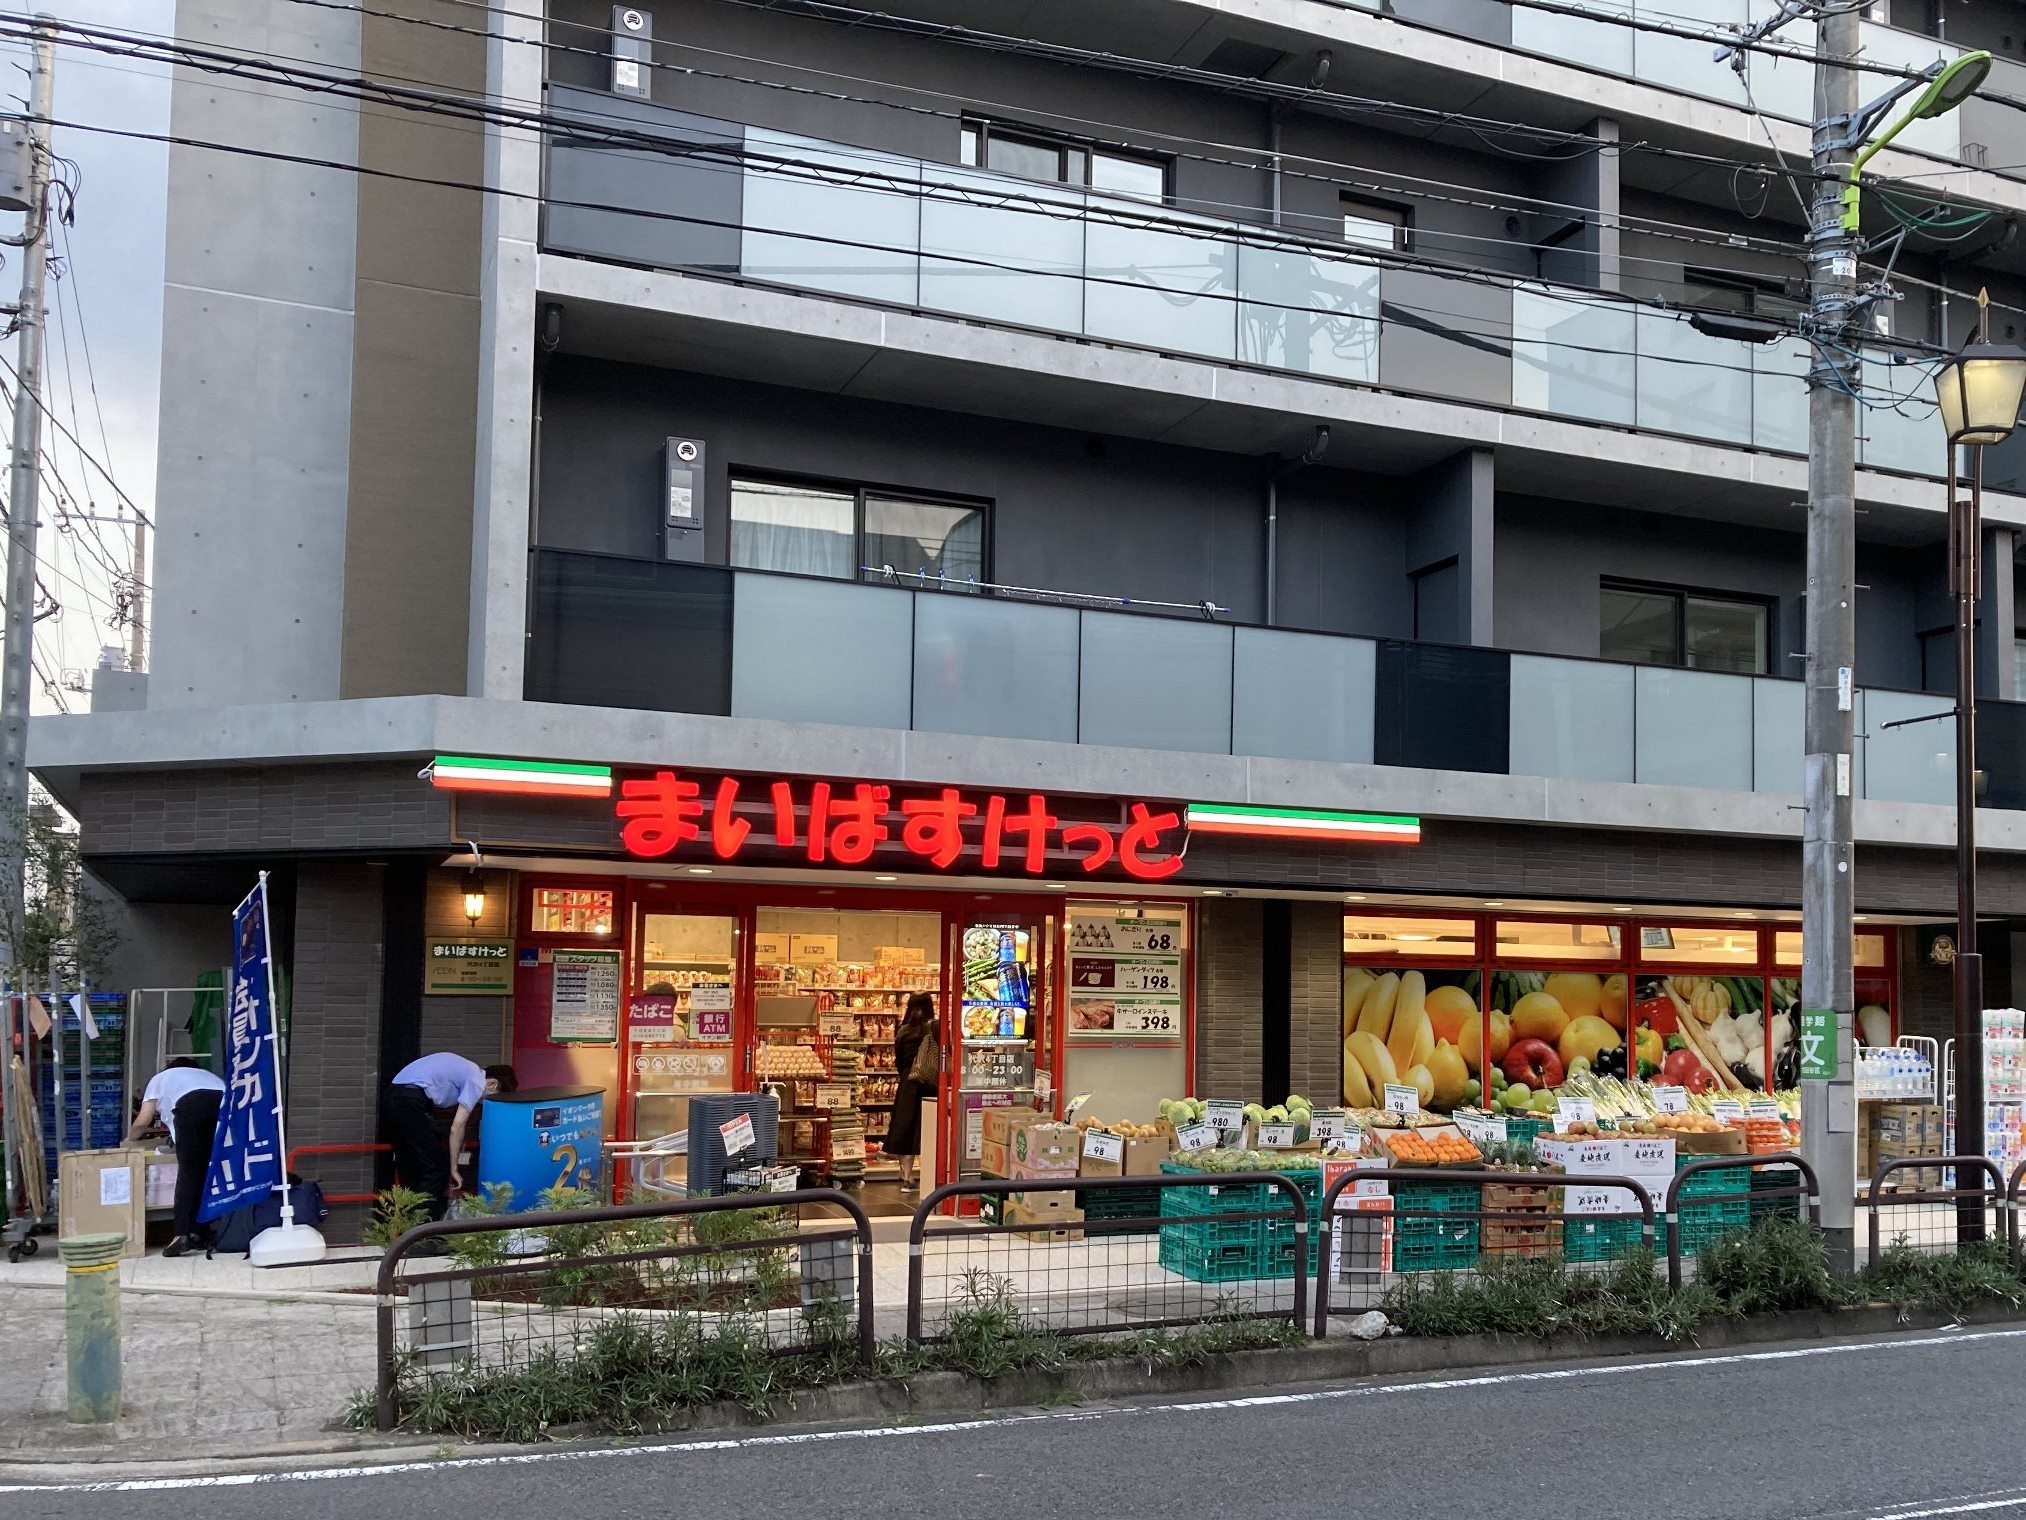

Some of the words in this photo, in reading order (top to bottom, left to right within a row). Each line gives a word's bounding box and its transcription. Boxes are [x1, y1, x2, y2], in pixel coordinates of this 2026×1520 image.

[616, 771, 1184, 879] まいばすけっと
[1147, 934, 1171, 950] 68
[433, 945, 507, 957] まいばすけっと
[1143, 975, 1169, 989] 198
[629, 1003, 672, 1019] たばこ
[703, 1013, 726, 1024] 銀行
[1141, 1016, 1170, 1030] 398
[703, 1024, 726, 1033] ATM
[829, 1025, 841, 1033] 88
[1801, 1030, 1826, 1066] 文
[827, 1098, 839, 1106] 88
[1394, 1101, 1404, 1111] 98
[1663, 1102, 1674, 1111] 78
[1570, 1112, 1581, 1121] 98
[1212, 1117, 1228, 1127] 980
[1189, 1138, 1200, 1148] 98
[1267, 1135, 1278, 1144] 98
[1094, 1146, 1105, 1156] 98
[551, 1144, 578, 1198] 2
